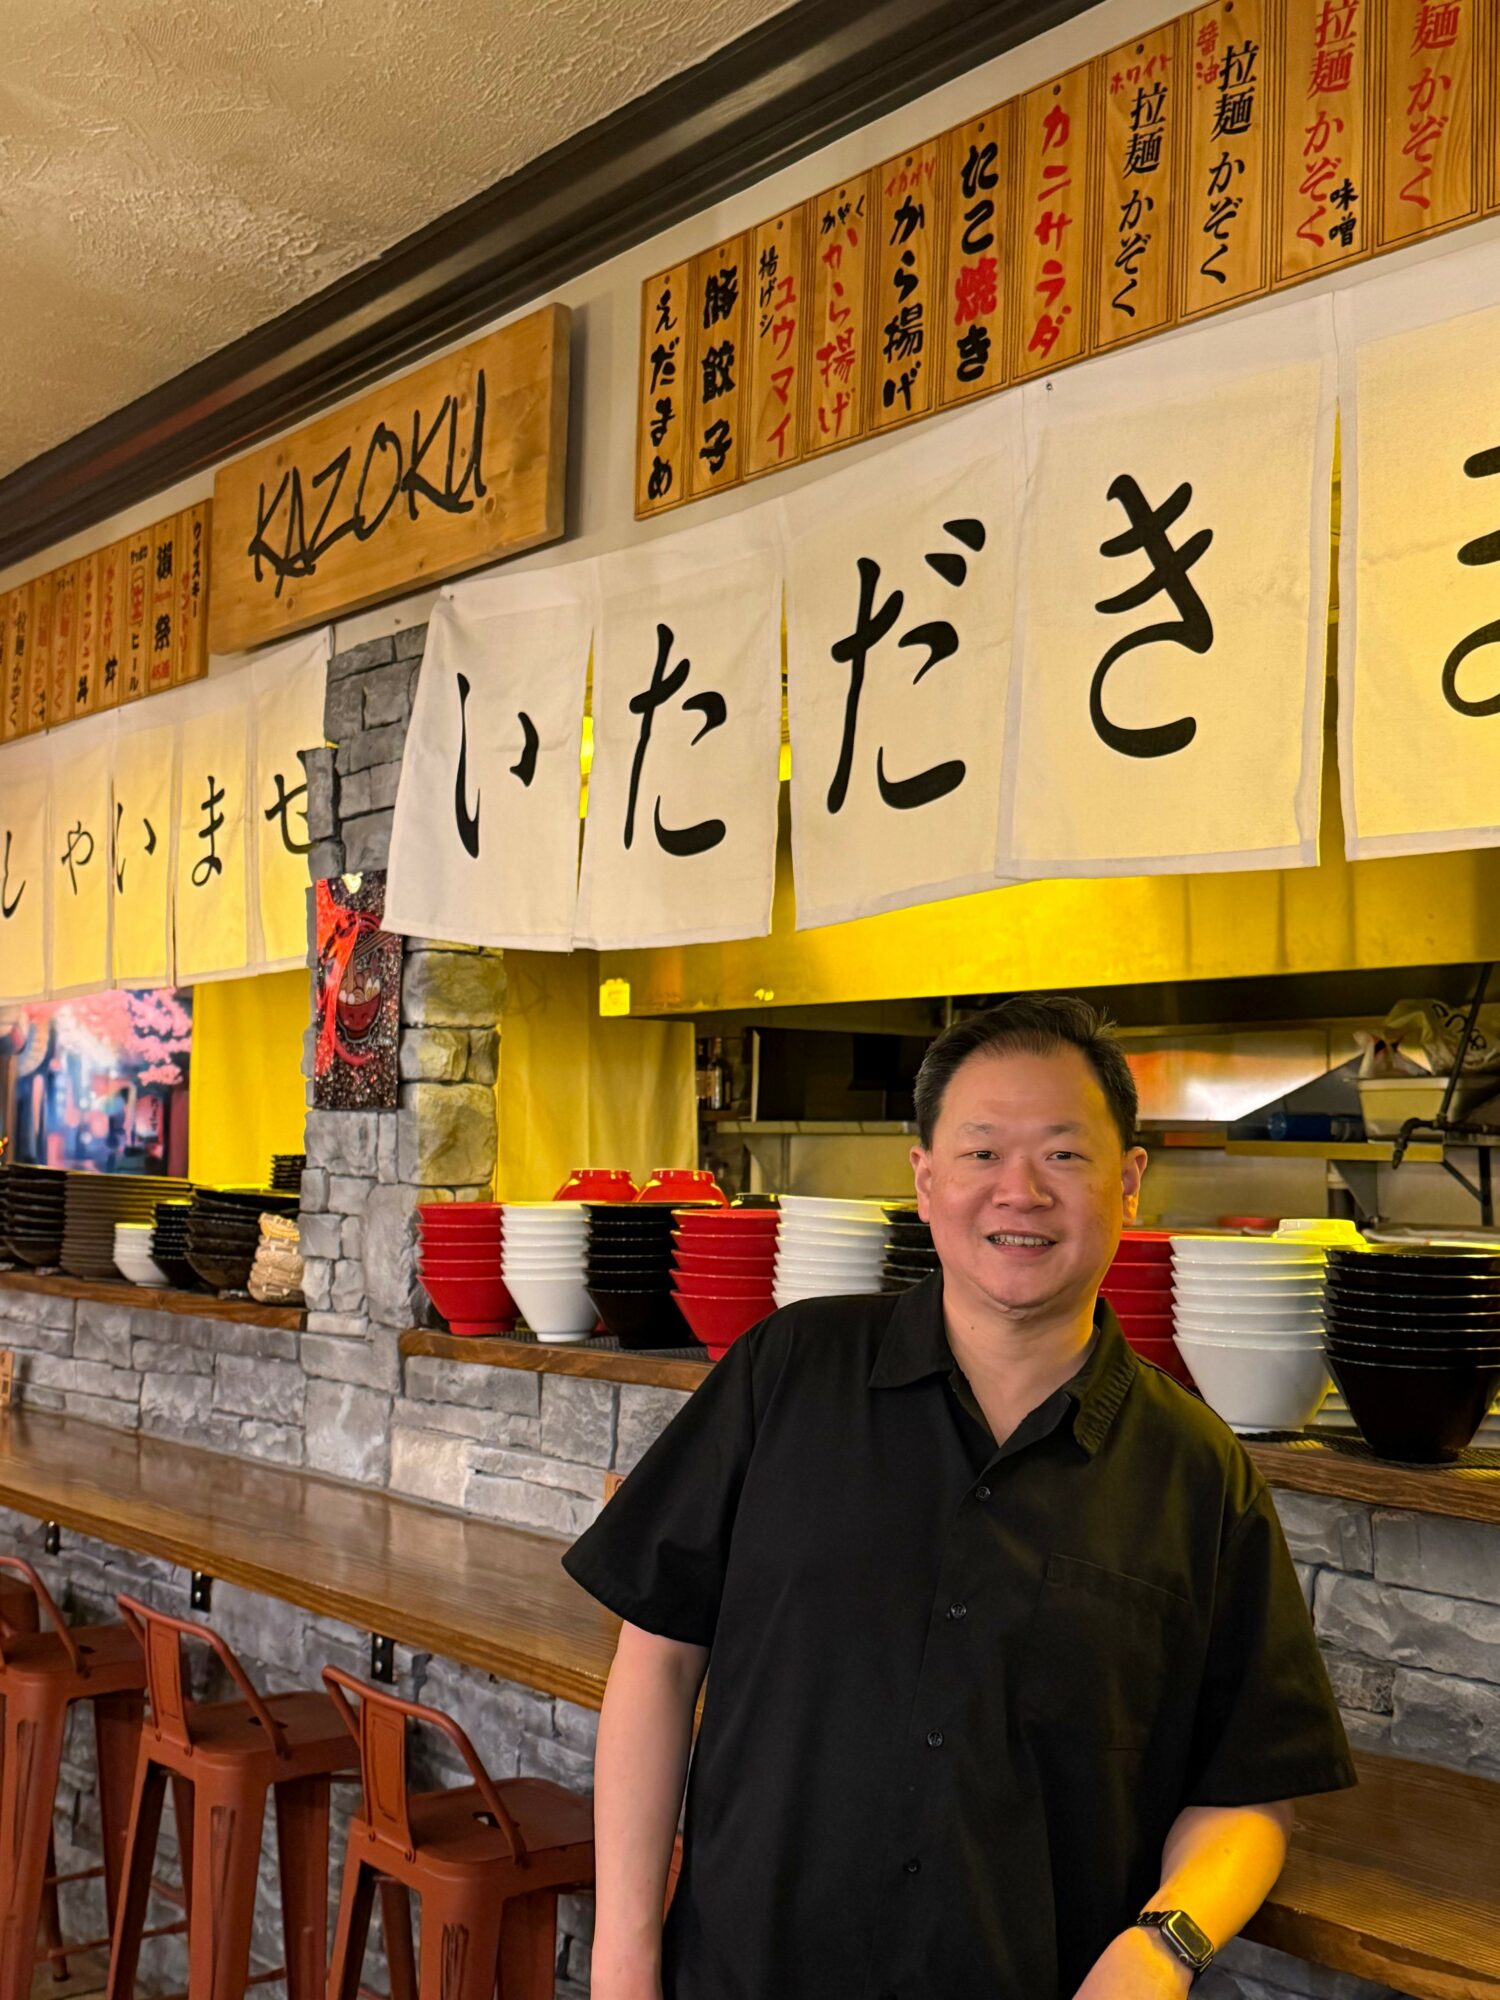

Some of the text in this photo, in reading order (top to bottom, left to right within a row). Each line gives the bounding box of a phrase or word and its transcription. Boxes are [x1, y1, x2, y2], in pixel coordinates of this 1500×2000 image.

[883, 195, 926, 412] から揚げ
[1027, 104, 1074, 361] カニサラダ
[248, 368, 488, 599] KAZOKU
[648, 289, 681, 500] えだまめ
